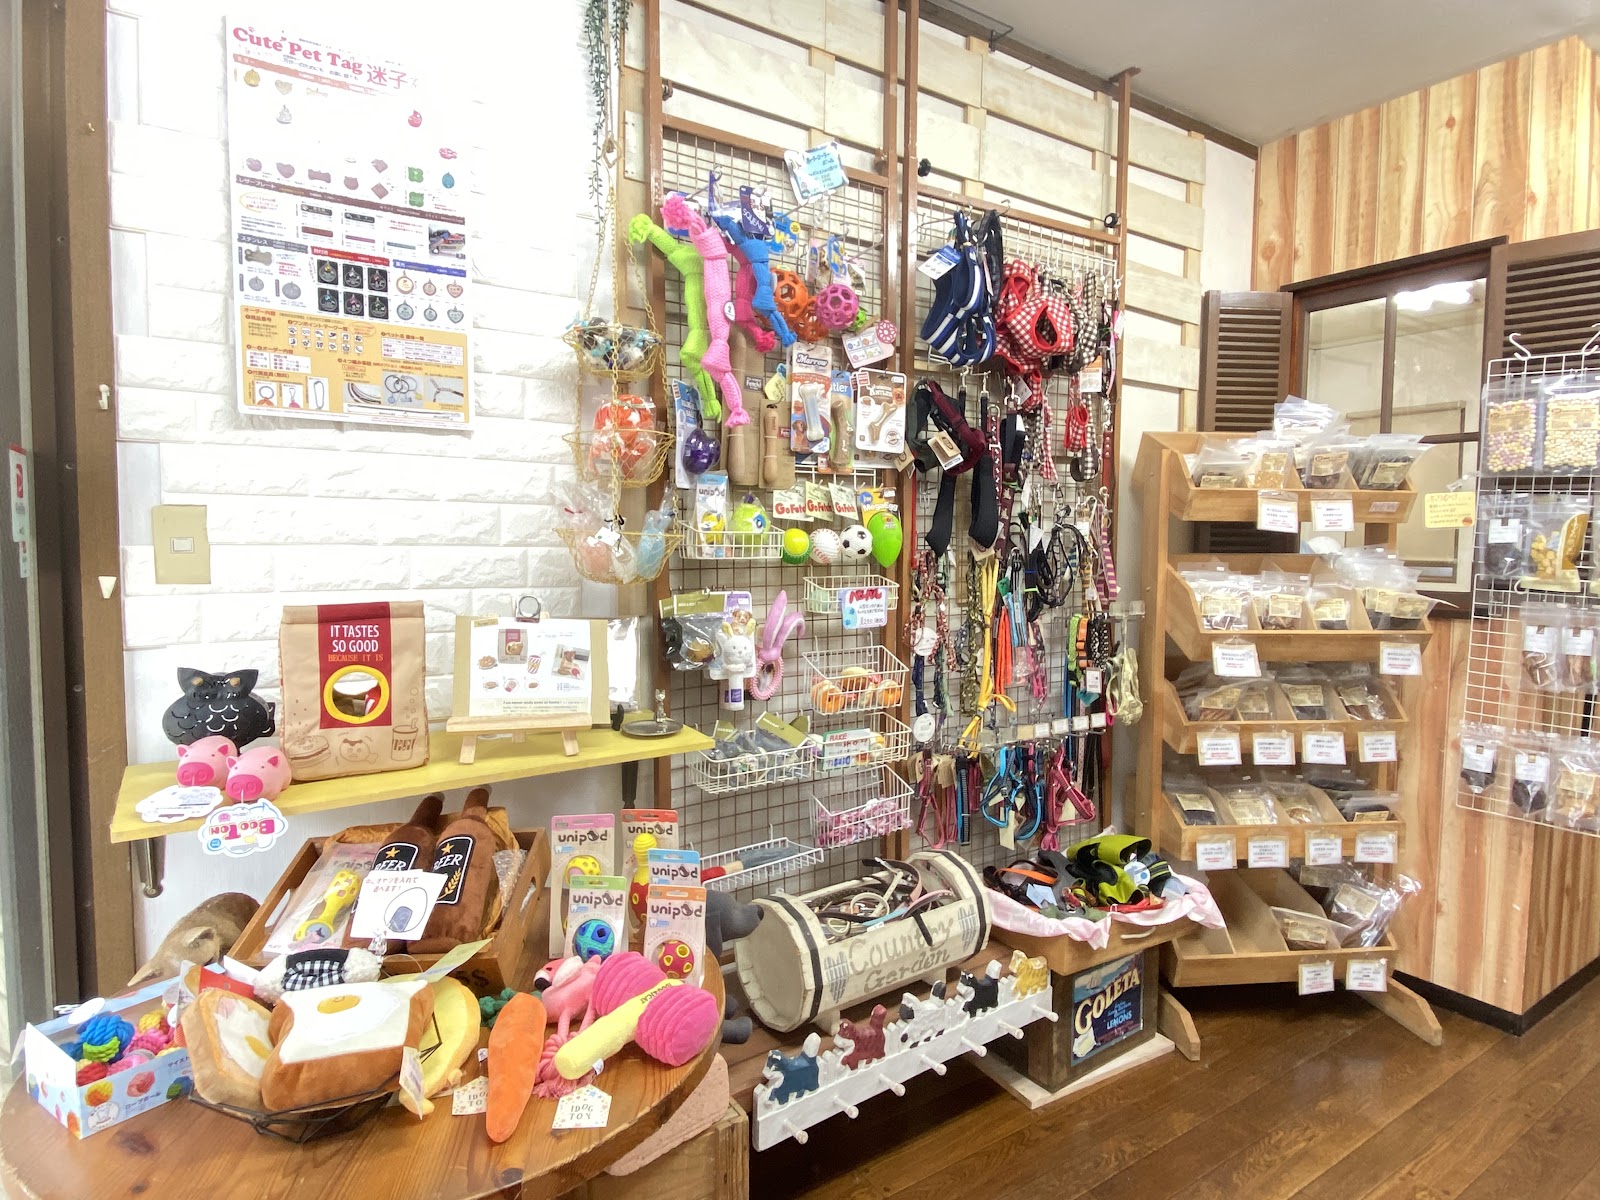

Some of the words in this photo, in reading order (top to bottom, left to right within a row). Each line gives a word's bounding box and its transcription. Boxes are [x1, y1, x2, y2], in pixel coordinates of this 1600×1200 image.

[233, 27, 283, 51] Cute
[288, 41, 322, 63] Pet
[327, 52, 363, 75] Tag
[331, 625, 340, 638] IT
[342, 625, 380, 638] TASTES
[332, 639, 346, 652] SO
[349, 639, 379, 652] GOOD
[328, 654, 359, 662] BECAUSE
[362, 654, 371, 662] IT
[375, 653, 384, 662] IS
[433, 854, 464, 870] BEER
[849, 916, 954, 976] Country
[863, 948, 950, 994] Garden
[1074, 968, 1141, 1035] GOLETA
[1107, 1010, 1133, 1030] LEMONS
[570, 1103, 594, 1112] IDOG
